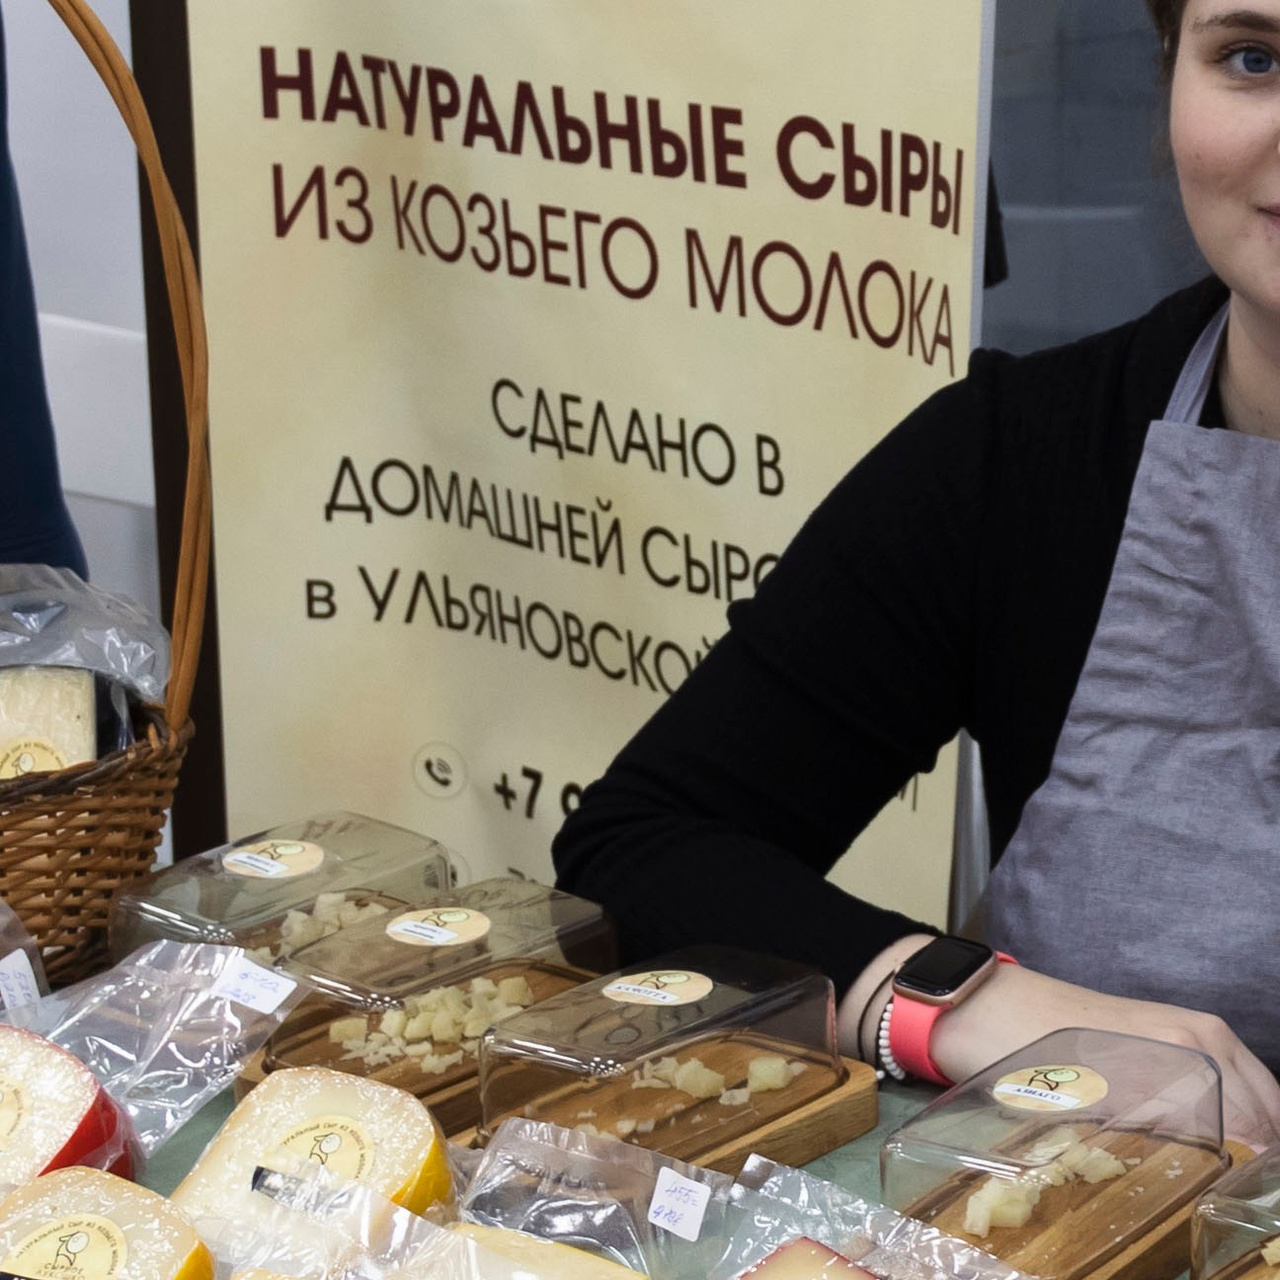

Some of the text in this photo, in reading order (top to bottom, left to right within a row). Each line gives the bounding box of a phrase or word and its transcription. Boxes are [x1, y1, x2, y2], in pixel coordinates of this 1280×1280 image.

[260, 46, 964, 236] НАТУРАЛЬНЫЕ СЫРЫ
[271, 163, 957, 378] ИЗ КОЗЬЕГО МОЛОКА
[492, 377, 785, 497] СДЕЛАНО В
[325, 456, 625, 576] ДОМАШНЕЙ
[357, 565, 717, 695] УЛЬЯНОВСКО
[494, 765, 543, 819] +7
